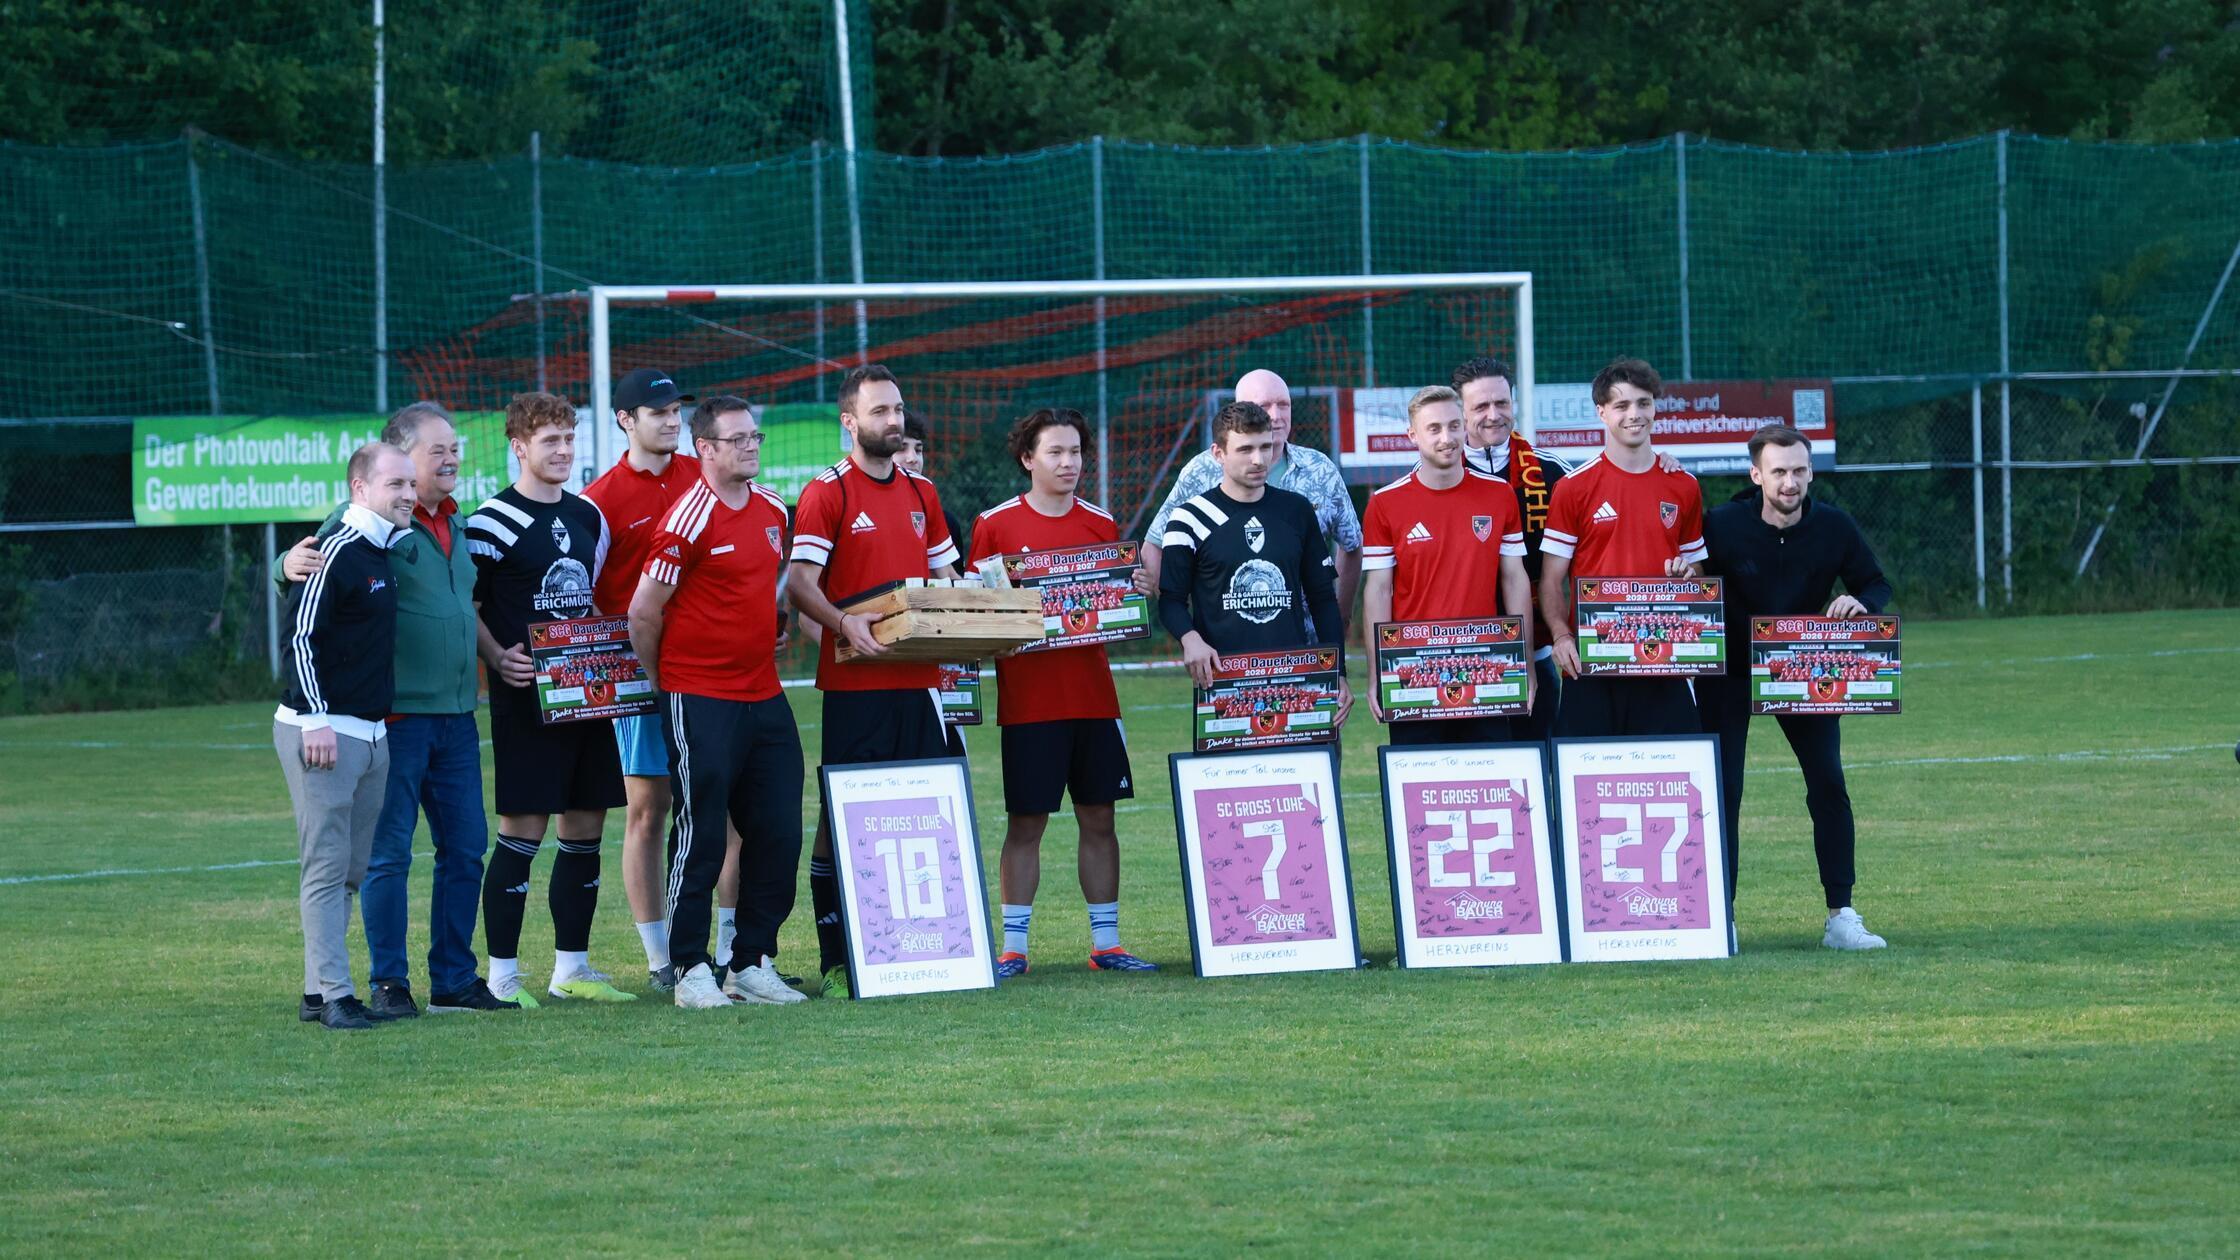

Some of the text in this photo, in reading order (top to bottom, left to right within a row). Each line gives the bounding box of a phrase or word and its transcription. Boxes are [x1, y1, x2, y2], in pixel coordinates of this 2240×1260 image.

[1653, 393, 1720, 412] erbe- und
[1537, 431, 1600, 445] NGSMAKLER
[145, 433, 186, 468] Der
[194, 431, 332, 466] Photovoltaik
[145, 475, 327, 512] Gewerbekunden
[1024, 548, 1119, 568] SCG Dauerkarte
[1048, 566, 1069, 574] 2026
[1076, 562, 1096, 571] 2027
[1602, 582, 1699, 594] SCG Dauerkarte
[534, 595, 592, 610] ERICHMÜHL
[1223, 595, 1292, 611] ERICHMÜHLE
[549, 619, 628, 638] SCG Dauerkarte
[1403, 623, 1500, 639] SCG Dauerkarte
[1776, 620, 1877, 632] SCG Dauerkarte
[569, 635, 588, 643] 2026
[593, 633, 610, 641] 2027
[1456, 636, 1477, 644] 2027
[1222, 653, 1317, 671] SCG Dauerkarte
[1589, 662, 1617, 674] Danke
[1244, 669, 1265, 677] 2026
[1393, 707, 1420, 720] Danke
[1761, 701, 1789, 713] Danke
[550, 708, 573, 721] Danke
[1206, 737, 1233, 750] Danke
[1393, 759, 1408, 769] Für
[1412, 760, 1438, 768] immer
[1442, 757, 1458, 767] Teil
[1581, 752, 1597, 762] Für
[1601, 754, 1623, 762] immer
[1631, 751, 1648, 761] Teil
[1203, 767, 1219, 777] Für
[1226, 768, 1247, 776] immer
[1252, 764, 1267, 775] Teil
[1597, 782, 1612, 797] SC
[1422, 790, 1437, 805] SC
[1217, 802, 1233, 817] SC
[864, 817, 878, 832] SC
[1425, 808, 1516, 888] 22
[1599, 802, 1689, 883] 27
[1242, 819, 1287, 900] 7
[875, 837, 946, 919] 18
[1459, 899, 1503, 908] Planung
[1633, 895, 1678, 905] Planung
[1456, 907, 1503, 918] BAUER
[1630, 903, 1678, 914] BAUER
[1261, 912, 1305, 922] Planung
[1257, 920, 1305, 932] BAUER
[904, 932, 943, 942] Planung
[1598, 937, 1677, 949] HERZVEREINS
[902, 939, 943, 952] BAUER
[1426, 943, 1509, 955] HERZVEREINS
[1231, 949, 1297, 963] HERZVEREINS
[880, 969, 949, 984] HERZVEREINS
